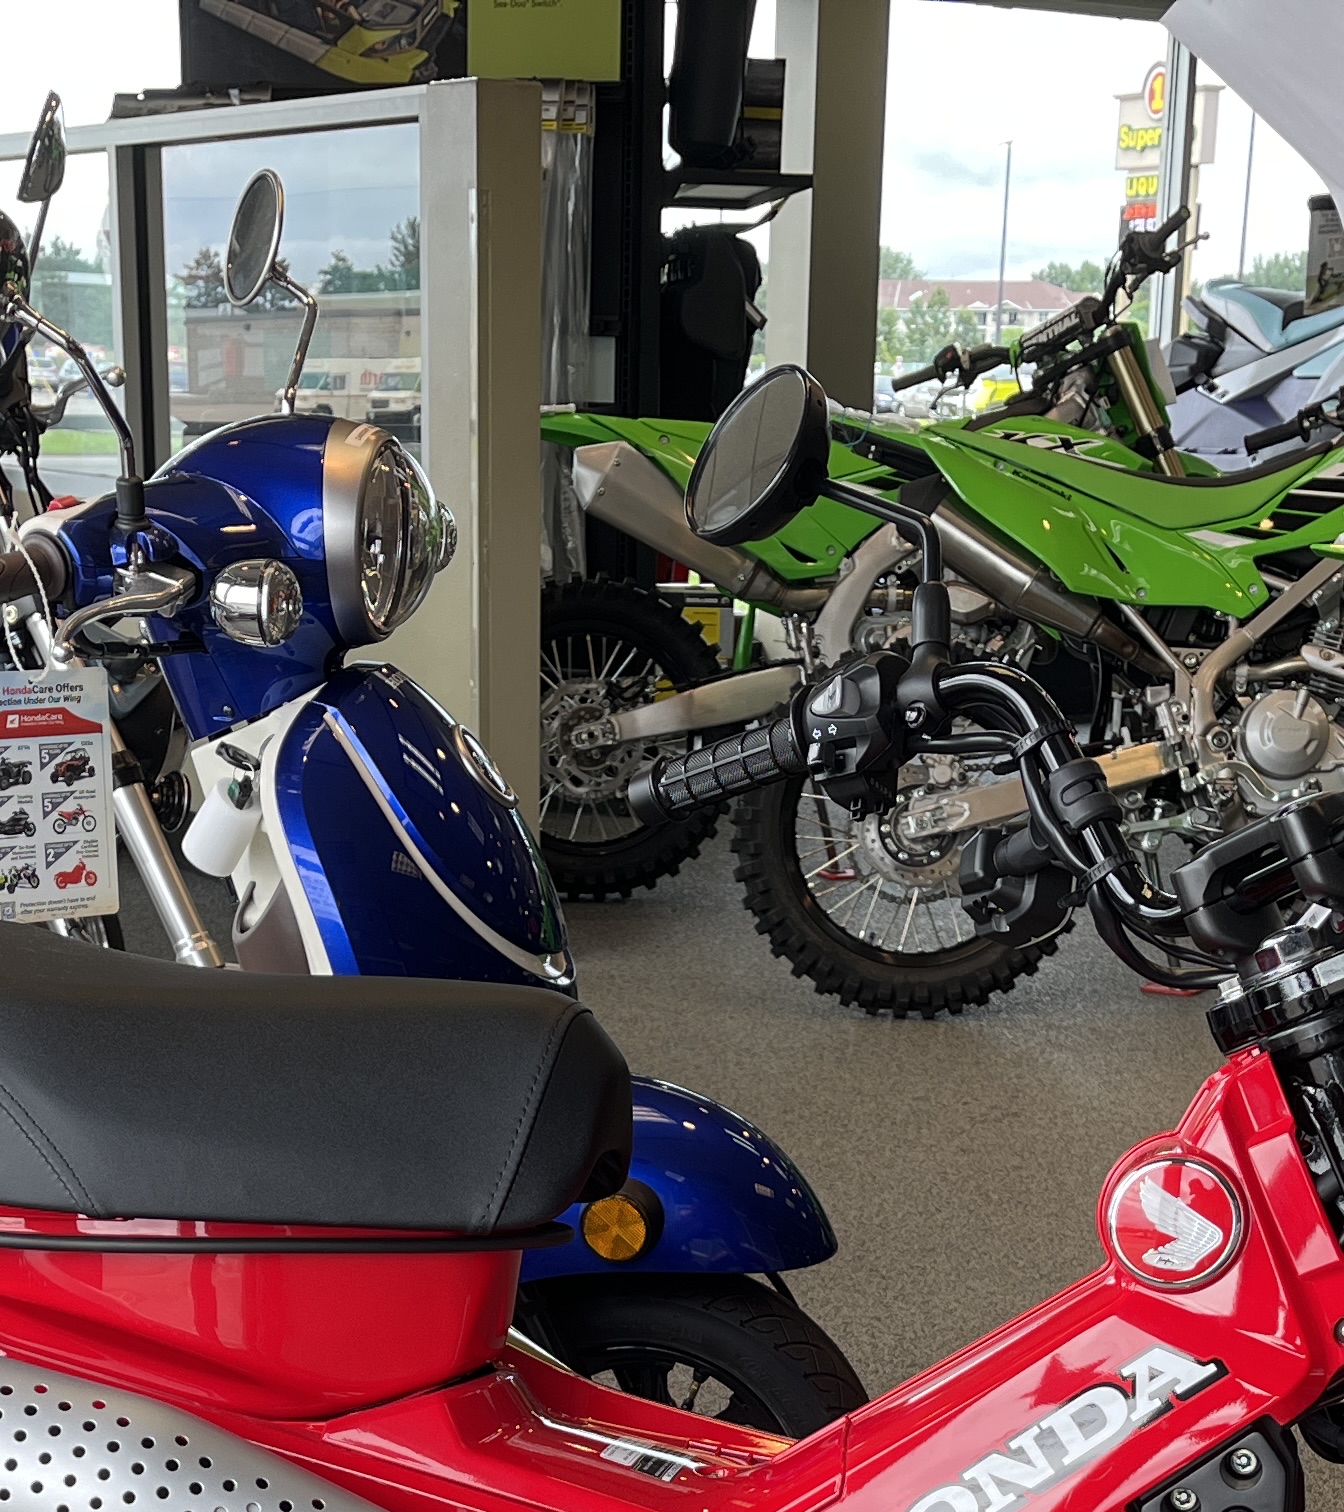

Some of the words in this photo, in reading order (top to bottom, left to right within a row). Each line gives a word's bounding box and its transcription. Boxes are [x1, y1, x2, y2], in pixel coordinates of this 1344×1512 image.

[1119, 124, 1162, 151] Super
[1126, 176, 1158, 196] LIQU
[55, 682, 84, 693] Offers
[41, 749, 50, 763] 5
[43, 798, 52, 812] 5
[46, 848, 56, 862] 2
